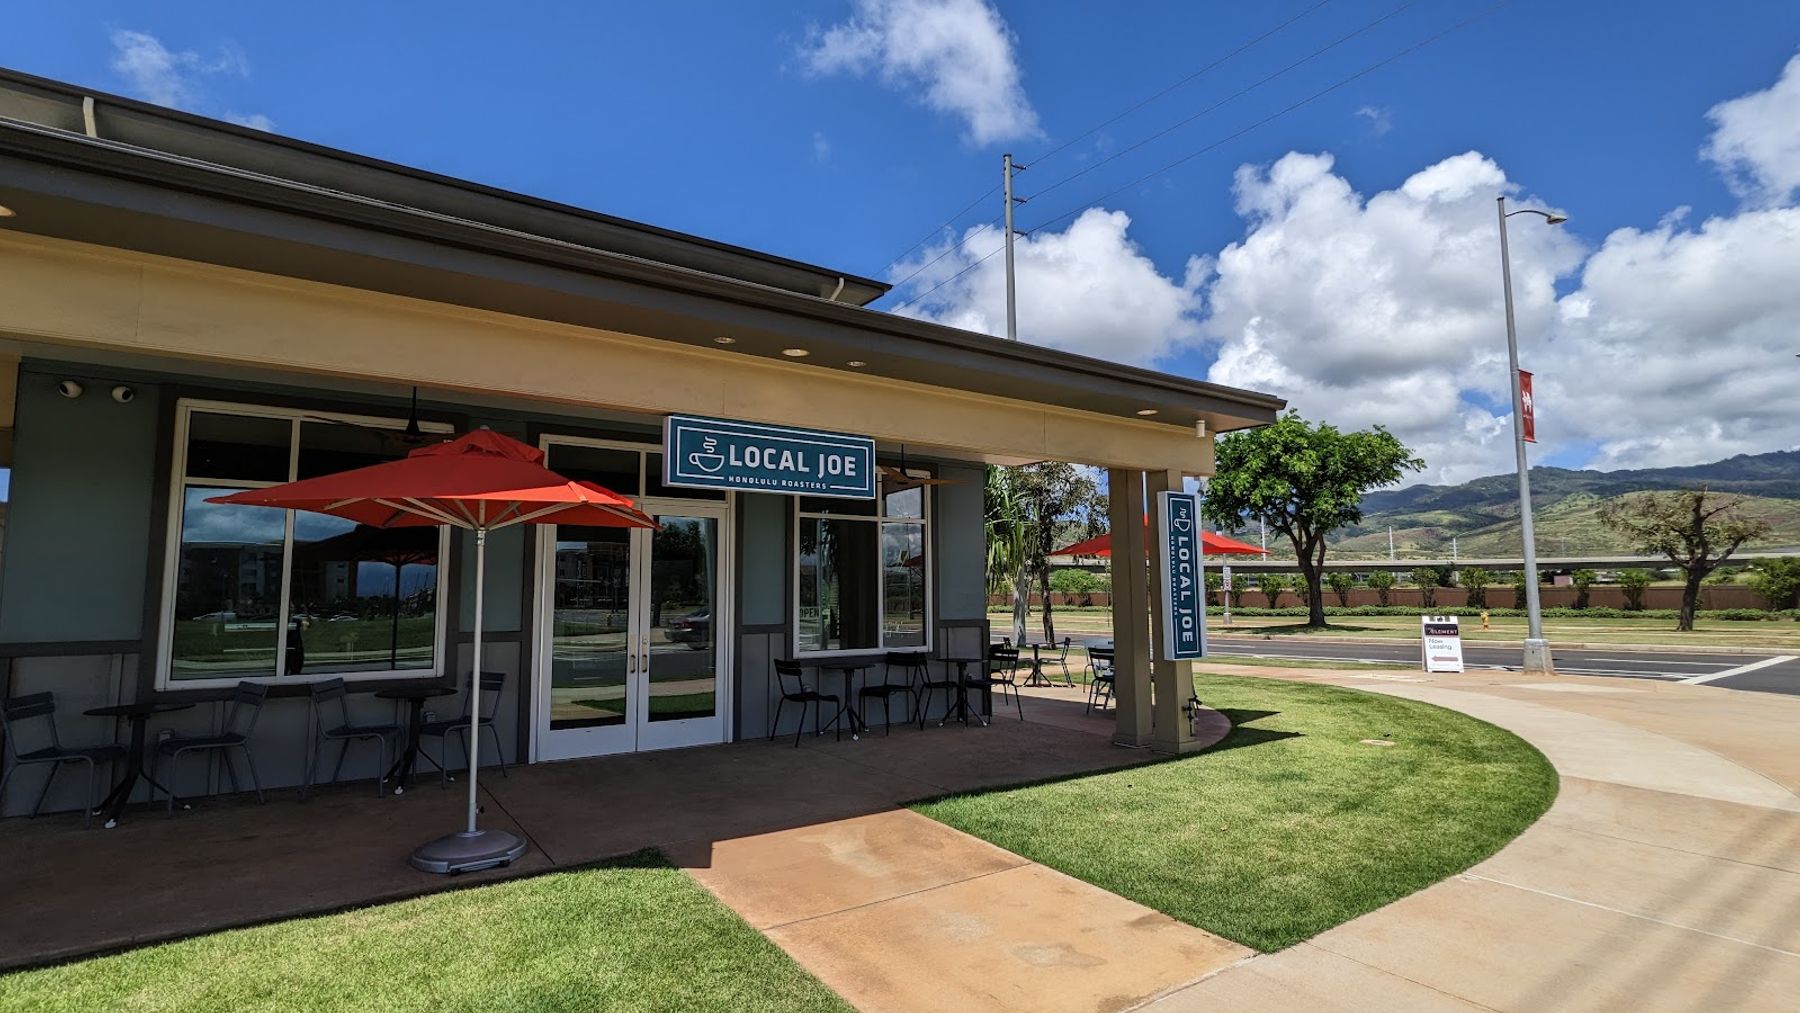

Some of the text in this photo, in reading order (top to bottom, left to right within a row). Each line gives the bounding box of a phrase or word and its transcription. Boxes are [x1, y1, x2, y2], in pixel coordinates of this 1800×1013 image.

[729, 444, 857, 480] LOCAL JOE
[728, 475, 827, 490] HONOLULU ROASTERS
[1178, 536, 1194, 642] LOCAL JOE
[800, 607, 820, 618] OPEN
